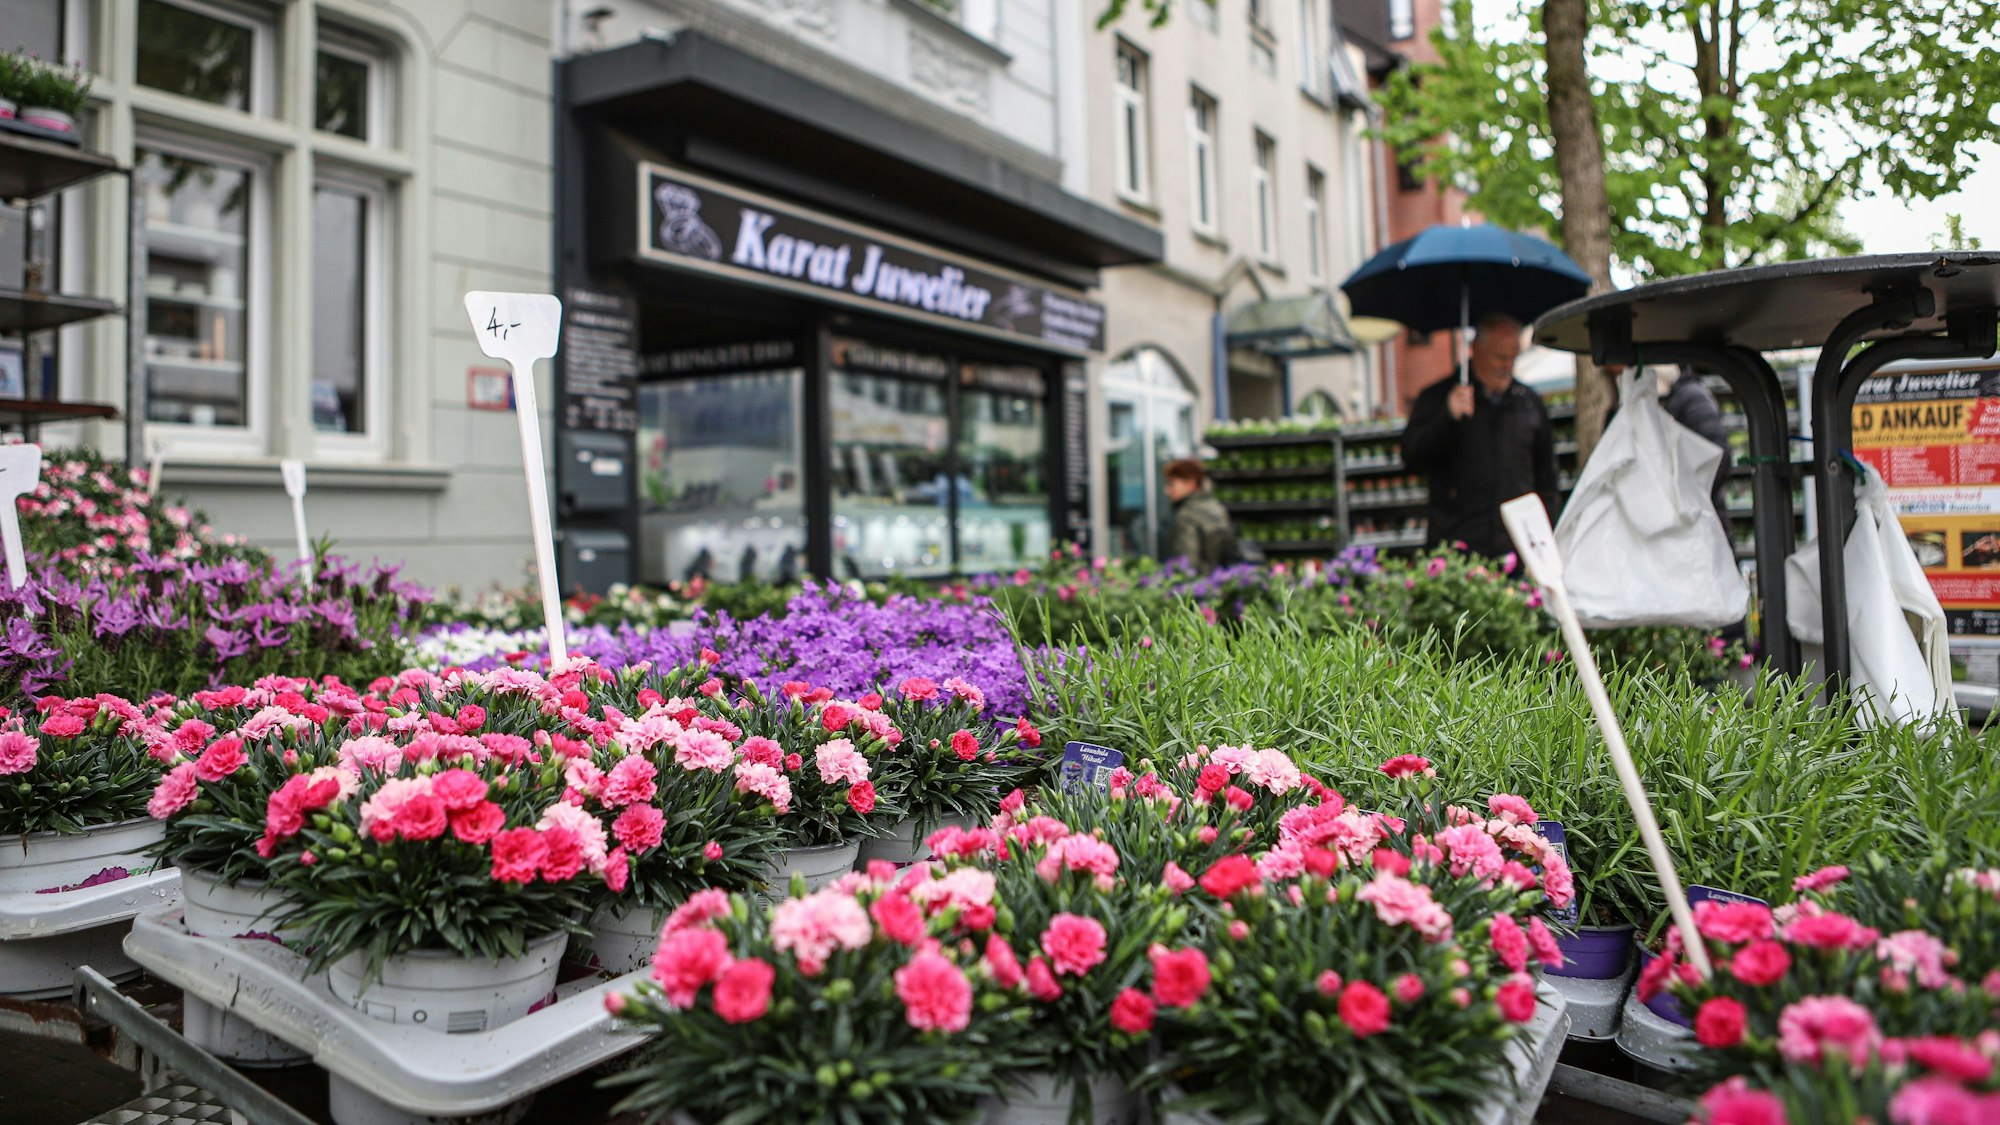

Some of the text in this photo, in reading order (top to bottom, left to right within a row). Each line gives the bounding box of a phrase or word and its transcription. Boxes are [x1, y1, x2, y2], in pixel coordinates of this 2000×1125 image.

[731, 207, 850, 289] Karat
[851, 243, 993, 322] Juwelier
[485, 306, 522, 341] 4,-
[1858, 370, 1981, 395] arat Juwelier
[1880, 403, 1964, 430] ANKAUF
